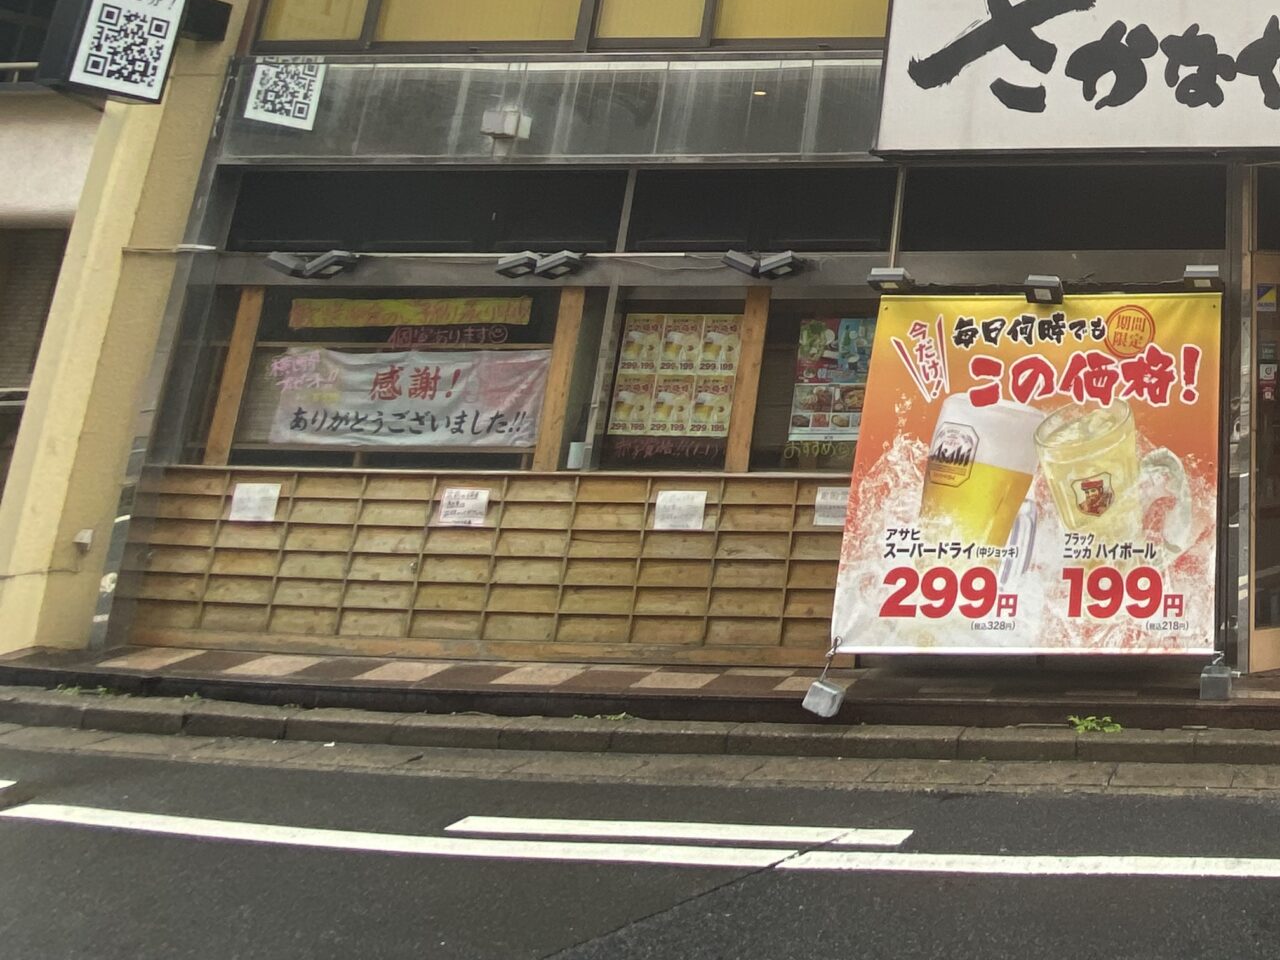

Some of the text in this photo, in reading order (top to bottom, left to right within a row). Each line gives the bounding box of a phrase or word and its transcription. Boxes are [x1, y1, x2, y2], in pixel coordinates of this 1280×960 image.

[952, 312, 1107, 348] 毎日何時でも
[1114, 315, 1147, 333] 期間
[907, 322, 944, 398] 今だけ!
[968, 345, 1202, 407] この価格!
[370, 364, 462, 401] 感謝!
[289, 406, 526, 436] ありがとうございました!!
[886, 528, 920, 541] アサヒ
[1063, 544, 1157, 560] ニッカ ハイボール
[1064, 532, 1095, 546] ブラック
[879, 566, 1018, 618] 299円
[1062, 566, 1184, 618] 199円
